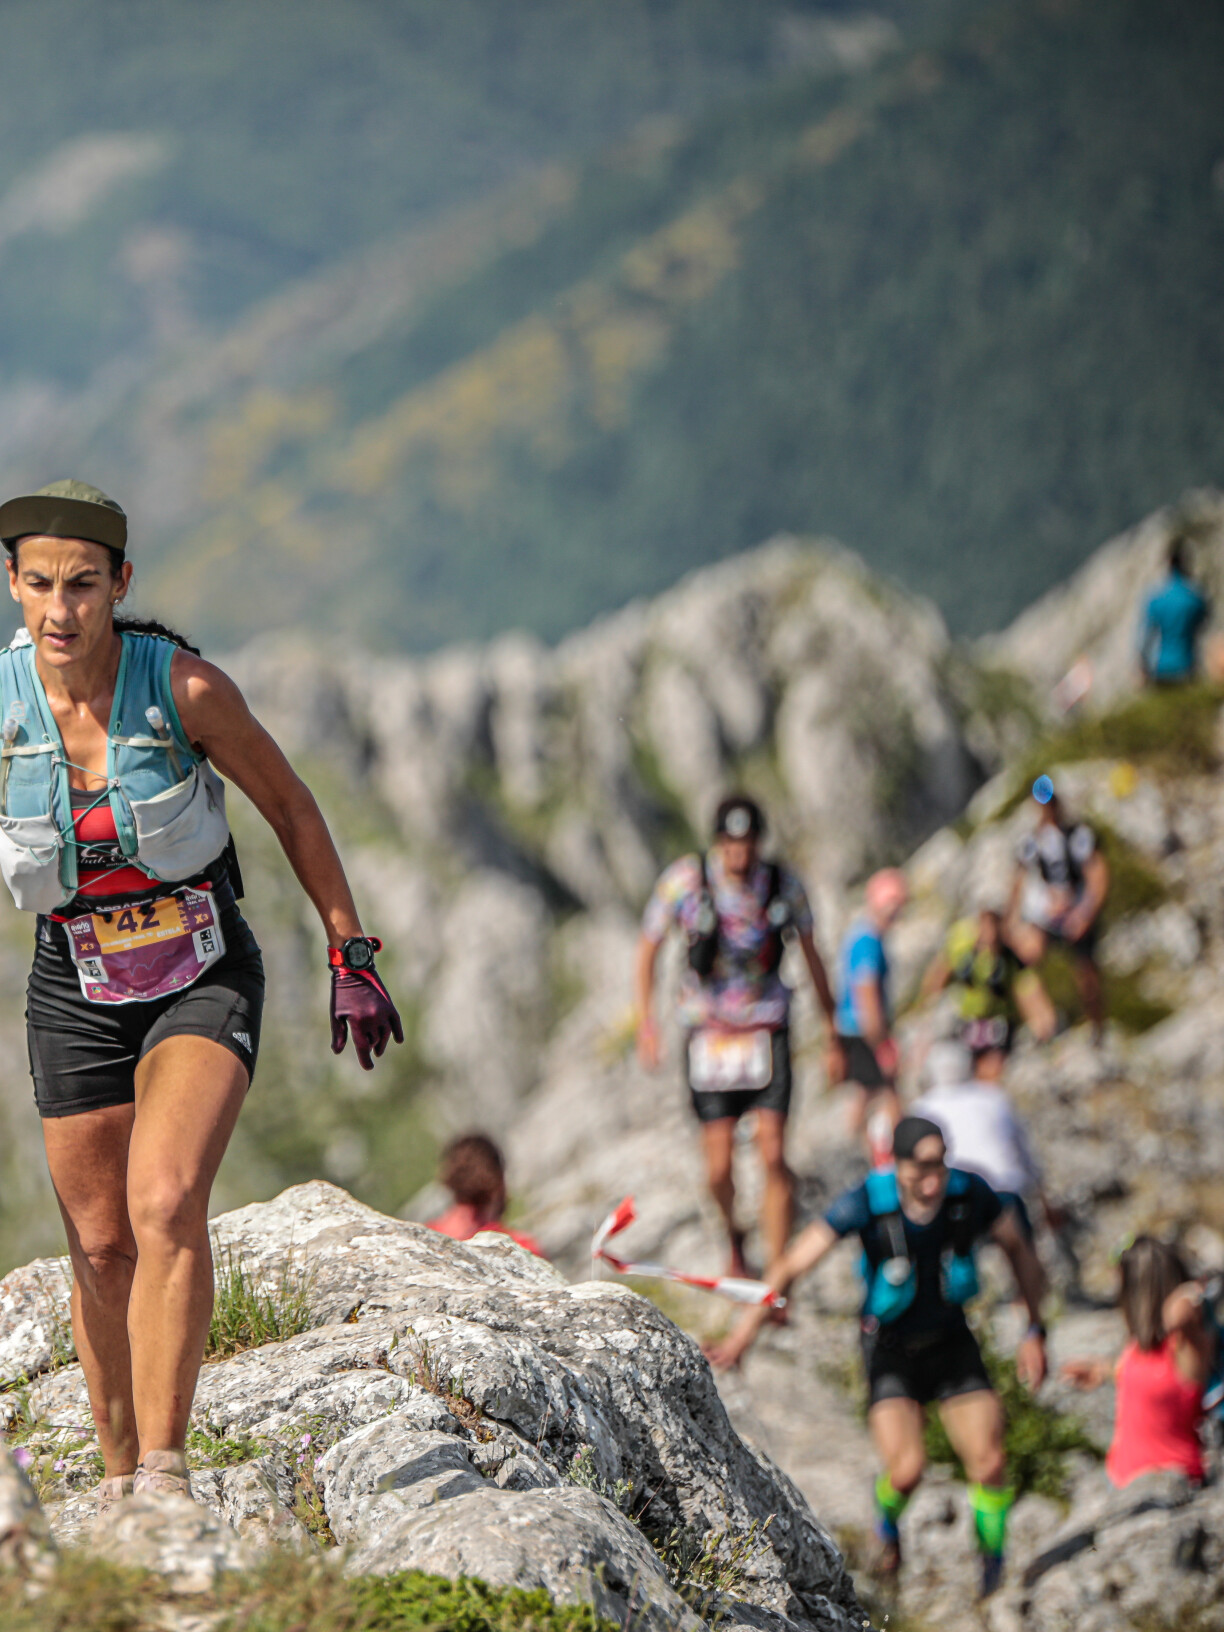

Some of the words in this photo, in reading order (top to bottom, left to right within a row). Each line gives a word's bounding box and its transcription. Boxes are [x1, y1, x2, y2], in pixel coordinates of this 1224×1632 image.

[117, 907, 160, 933] 42
[194, 913, 209, 924] X3
[80, 943, 95, 951] X3
